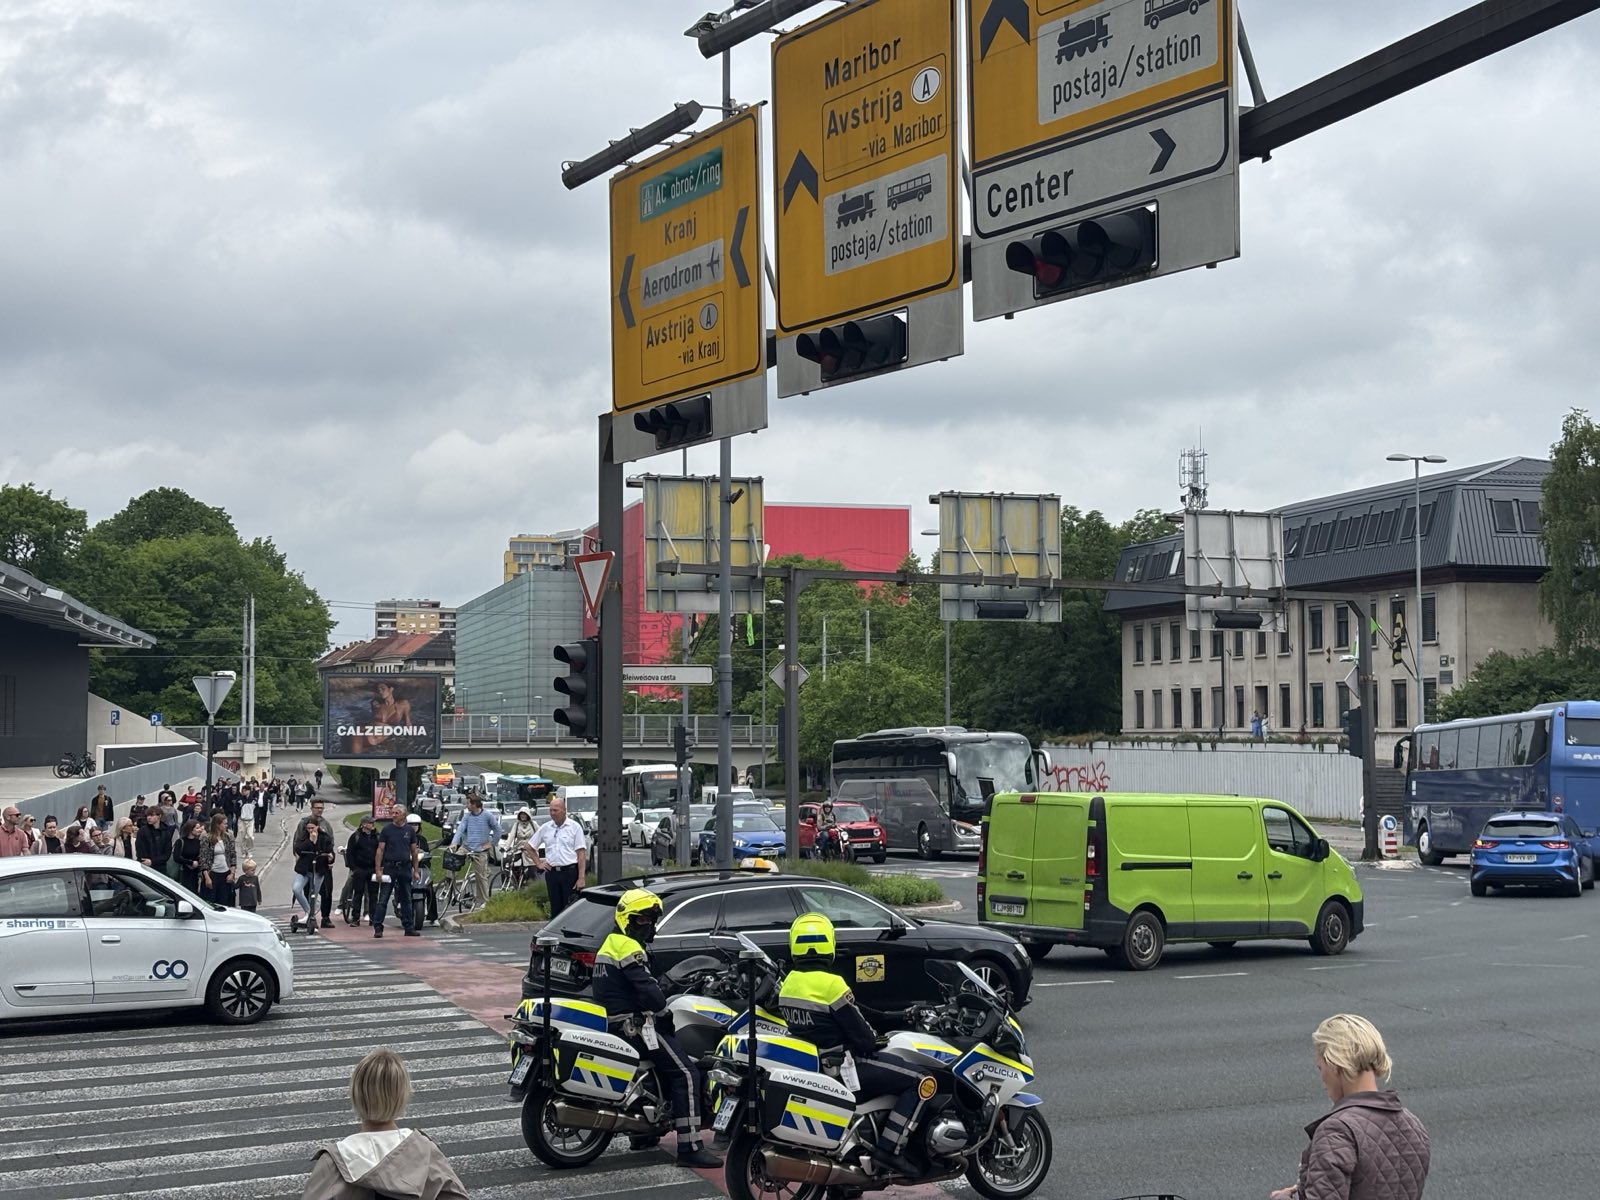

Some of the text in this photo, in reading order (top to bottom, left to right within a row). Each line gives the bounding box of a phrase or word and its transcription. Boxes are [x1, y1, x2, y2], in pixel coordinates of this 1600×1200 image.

[824, 37, 902, 90] Maribor
[1053, 34, 1201, 114] postaja/station
[921, 73, 931, 99] A
[826, 87, 903, 140] Avstrija
[893, 113, 943, 149] Maribor
[654, 181, 667, 207] AC
[987, 168, 1074, 218] Center
[664, 211, 697, 246] Kranj
[831, 213, 933, 270] postaja/station
[643, 260, 702, 300] Aerodrom
[646, 313, 694, 349] Avstrija
[705, 311, 712, 327] A
[698, 336, 720, 360] Kranj
[336, 725, 427, 736] CALZEDONIA
[6, 919, 54, 929] sharing
[780, 1007, 815, 1026] OLICIJA
[571, 1033, 632, 1054] WWW.POLICIJA.SI
[982, 1063, 1019, 1080] POLICIJA
[782, 1074, 848, 1097] WWW.POLICIJA.SI
